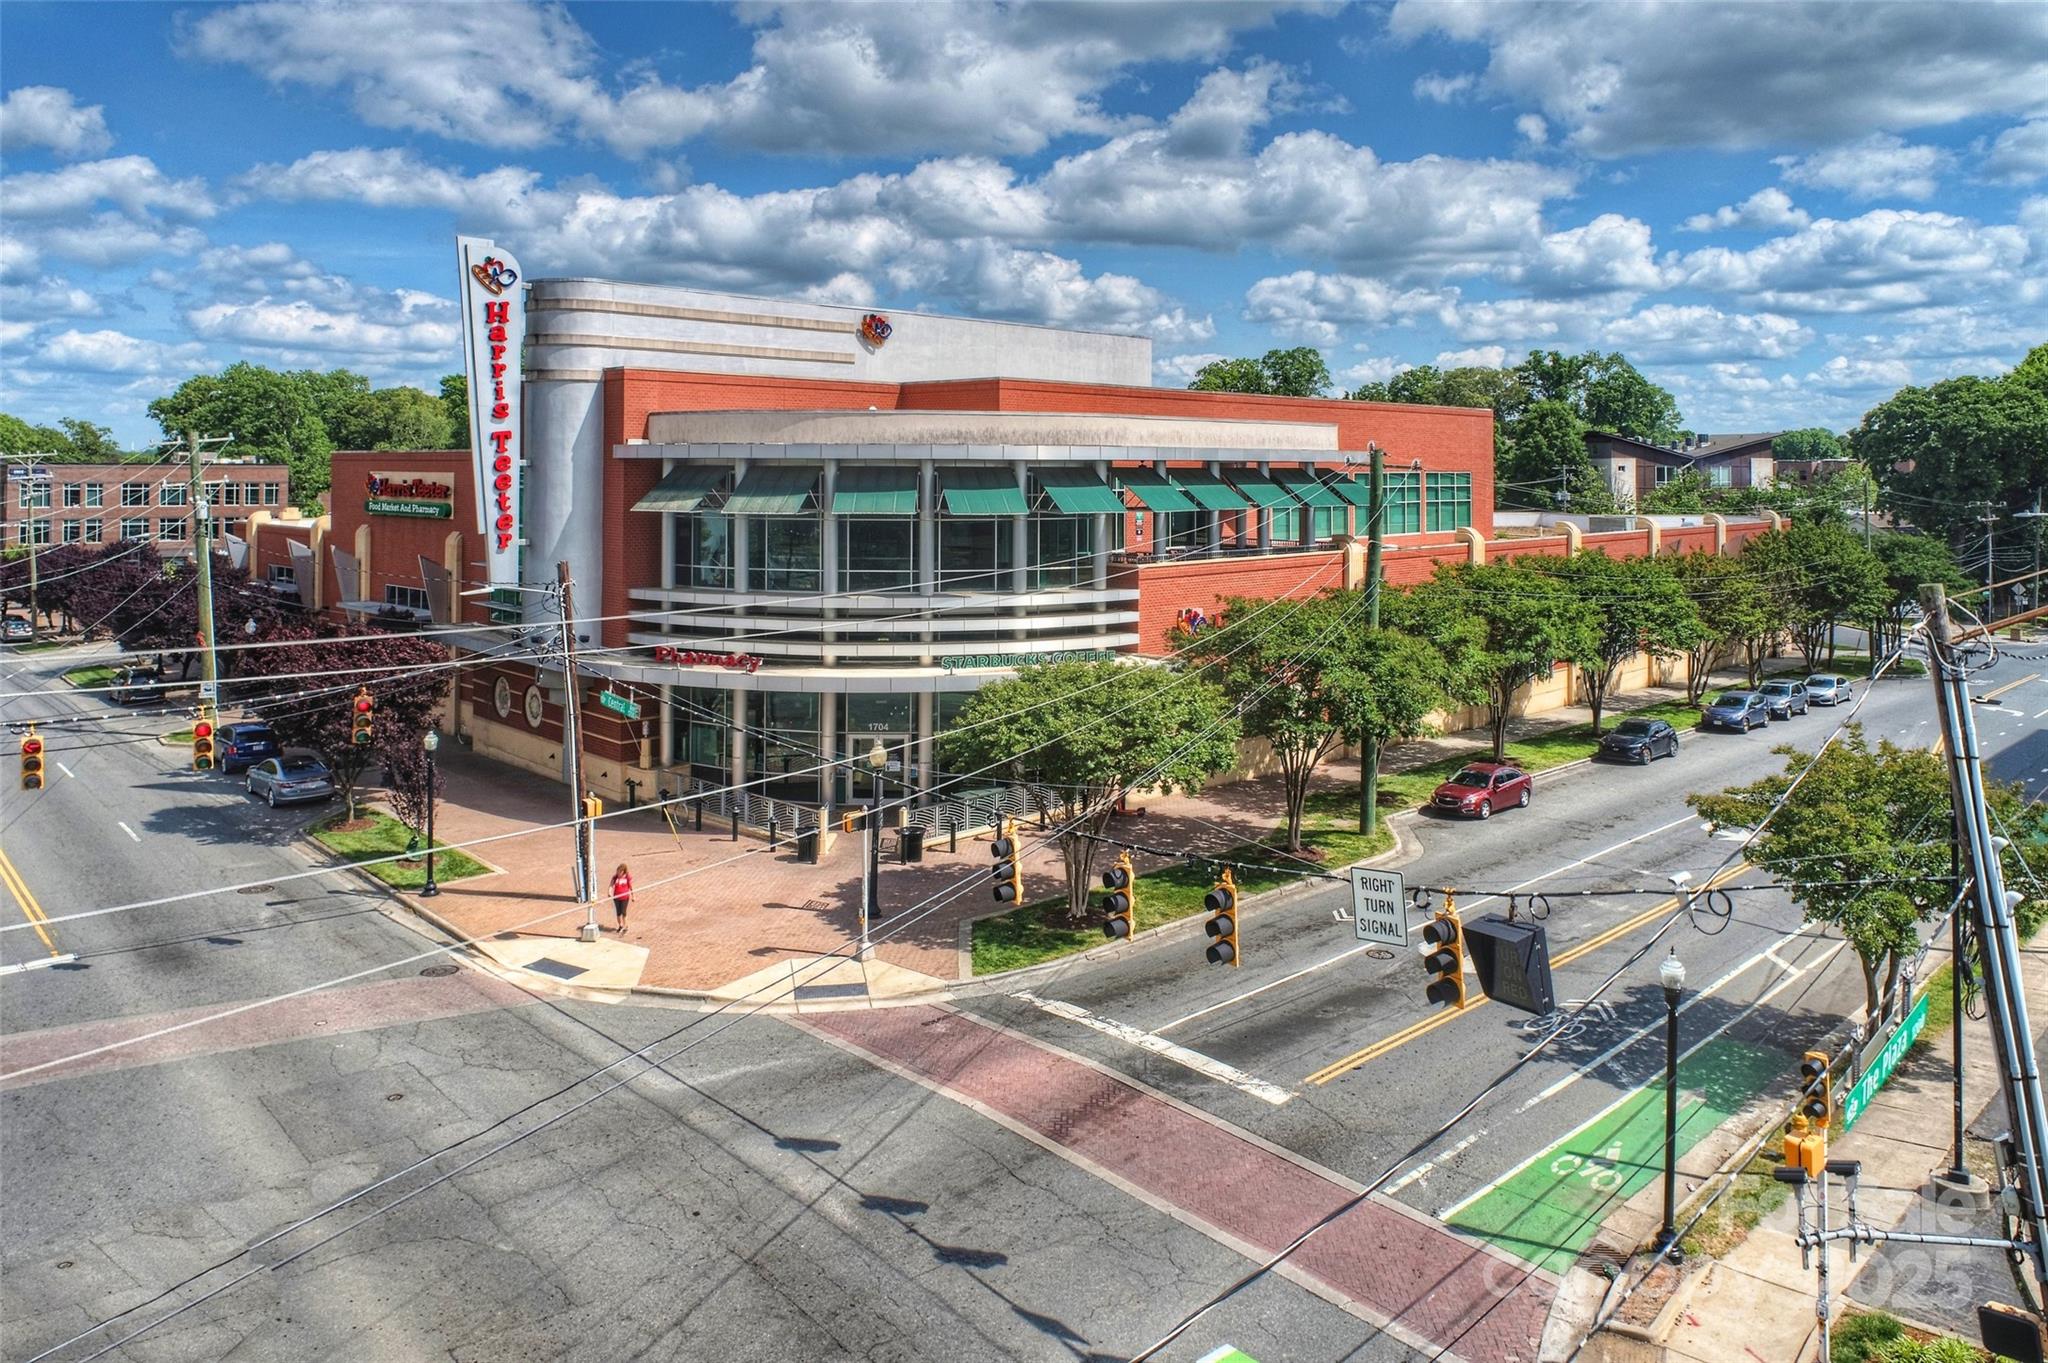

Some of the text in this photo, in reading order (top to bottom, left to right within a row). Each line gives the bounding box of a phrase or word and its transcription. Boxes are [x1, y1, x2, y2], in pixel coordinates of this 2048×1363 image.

[486, 301, 514, 549] Harris Teeter
[379, 477, 451, 499] Harris Teeter
[368, 502, 440, 516] Food Market And Pharmacy
[655, 645, 764, 673] Pharmacy
[941, 650, 1117, 670] STARBUCKS COFFEE
[868, 722, 889, 731] 1704
[1360, 876, 1395, 894] RIGHT
[1363, 897, 1395, 915] TURN
[1360, 918, 1403, 938] SIGNAL
[1861, 1030, 1907, 1106] The Plaza
